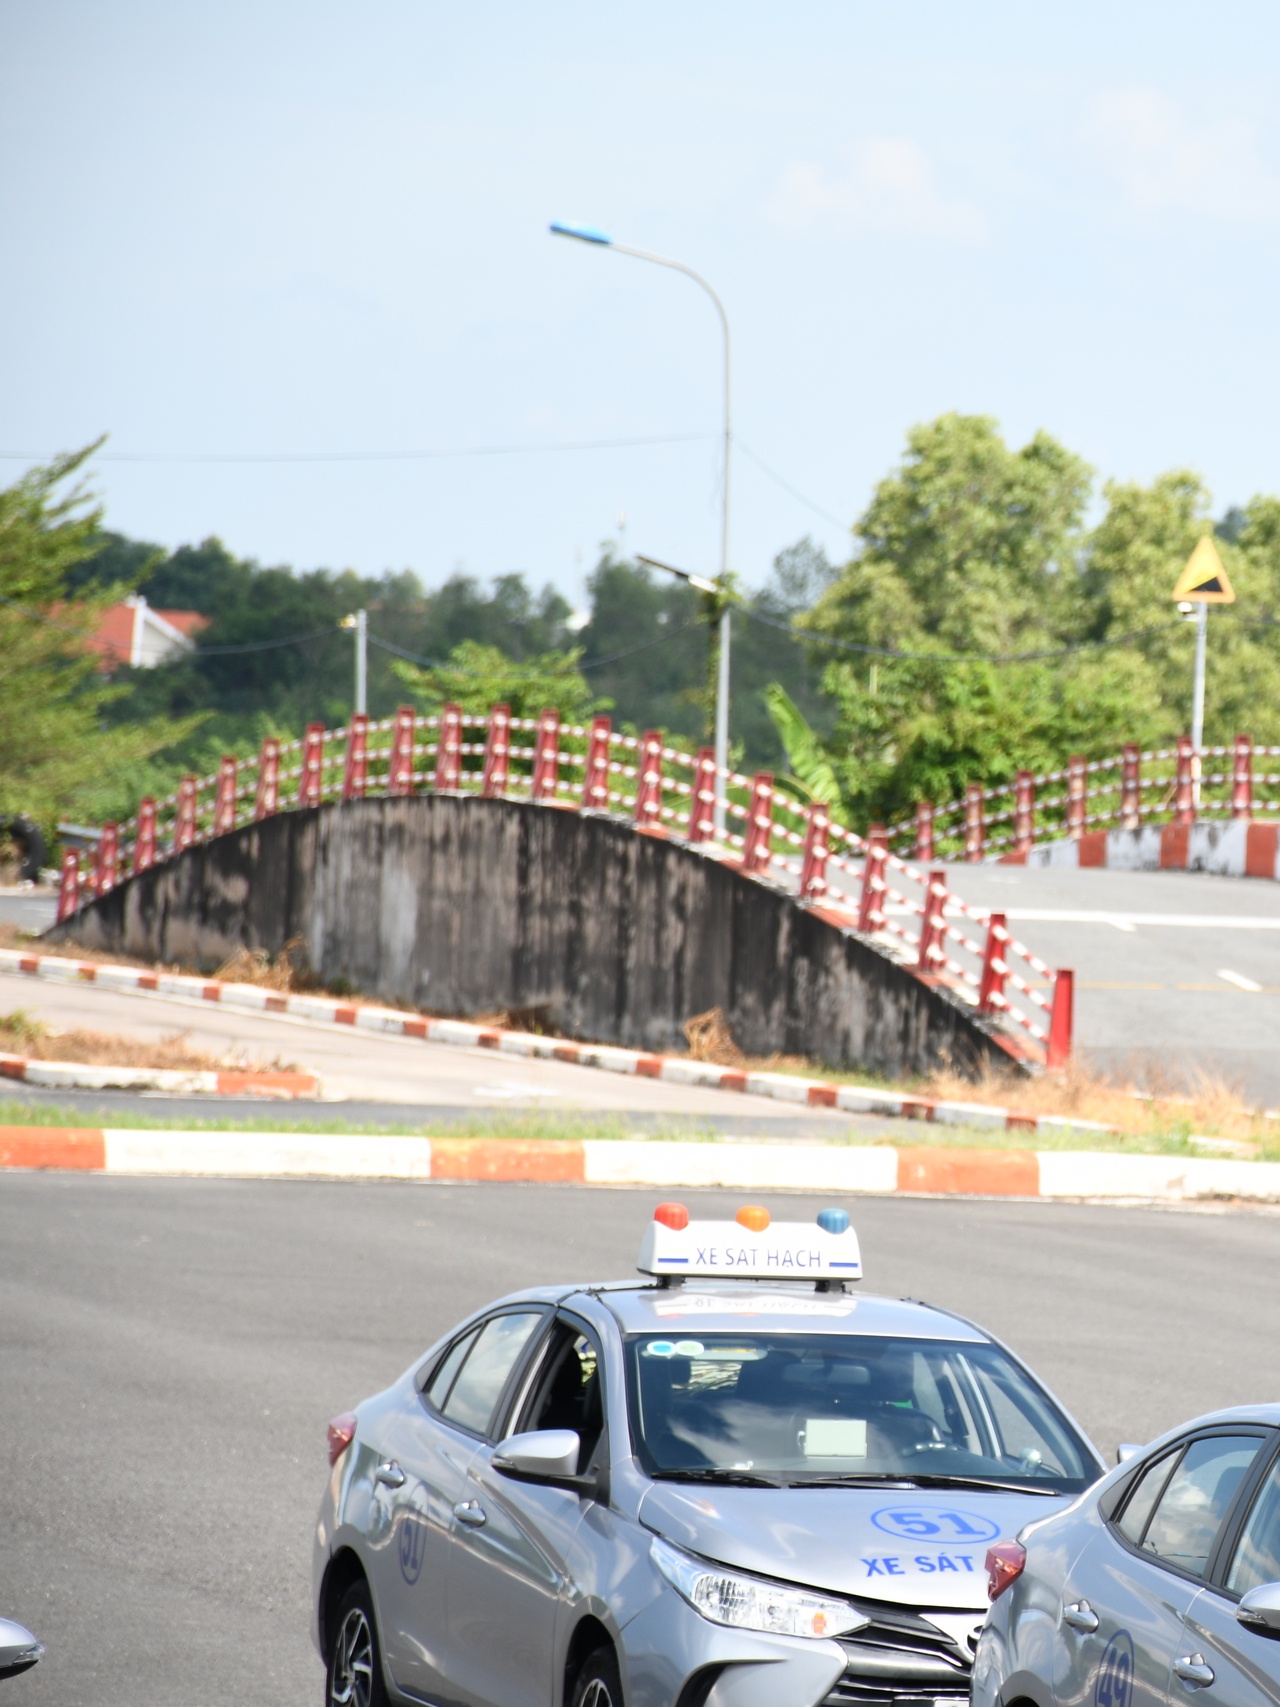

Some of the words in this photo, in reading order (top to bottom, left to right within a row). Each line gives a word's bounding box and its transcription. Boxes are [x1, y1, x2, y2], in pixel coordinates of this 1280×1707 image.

[696, 1247, 718, 1265] XE
[767, 1249, 821, 1268] HẠCH
[888, 1512, 987, 1535] 51
[860, 1557, 906, 1577] XE
[914, 1552, 974, 1573] SÁT
[1098, 1647, 1130, 1707] 49
